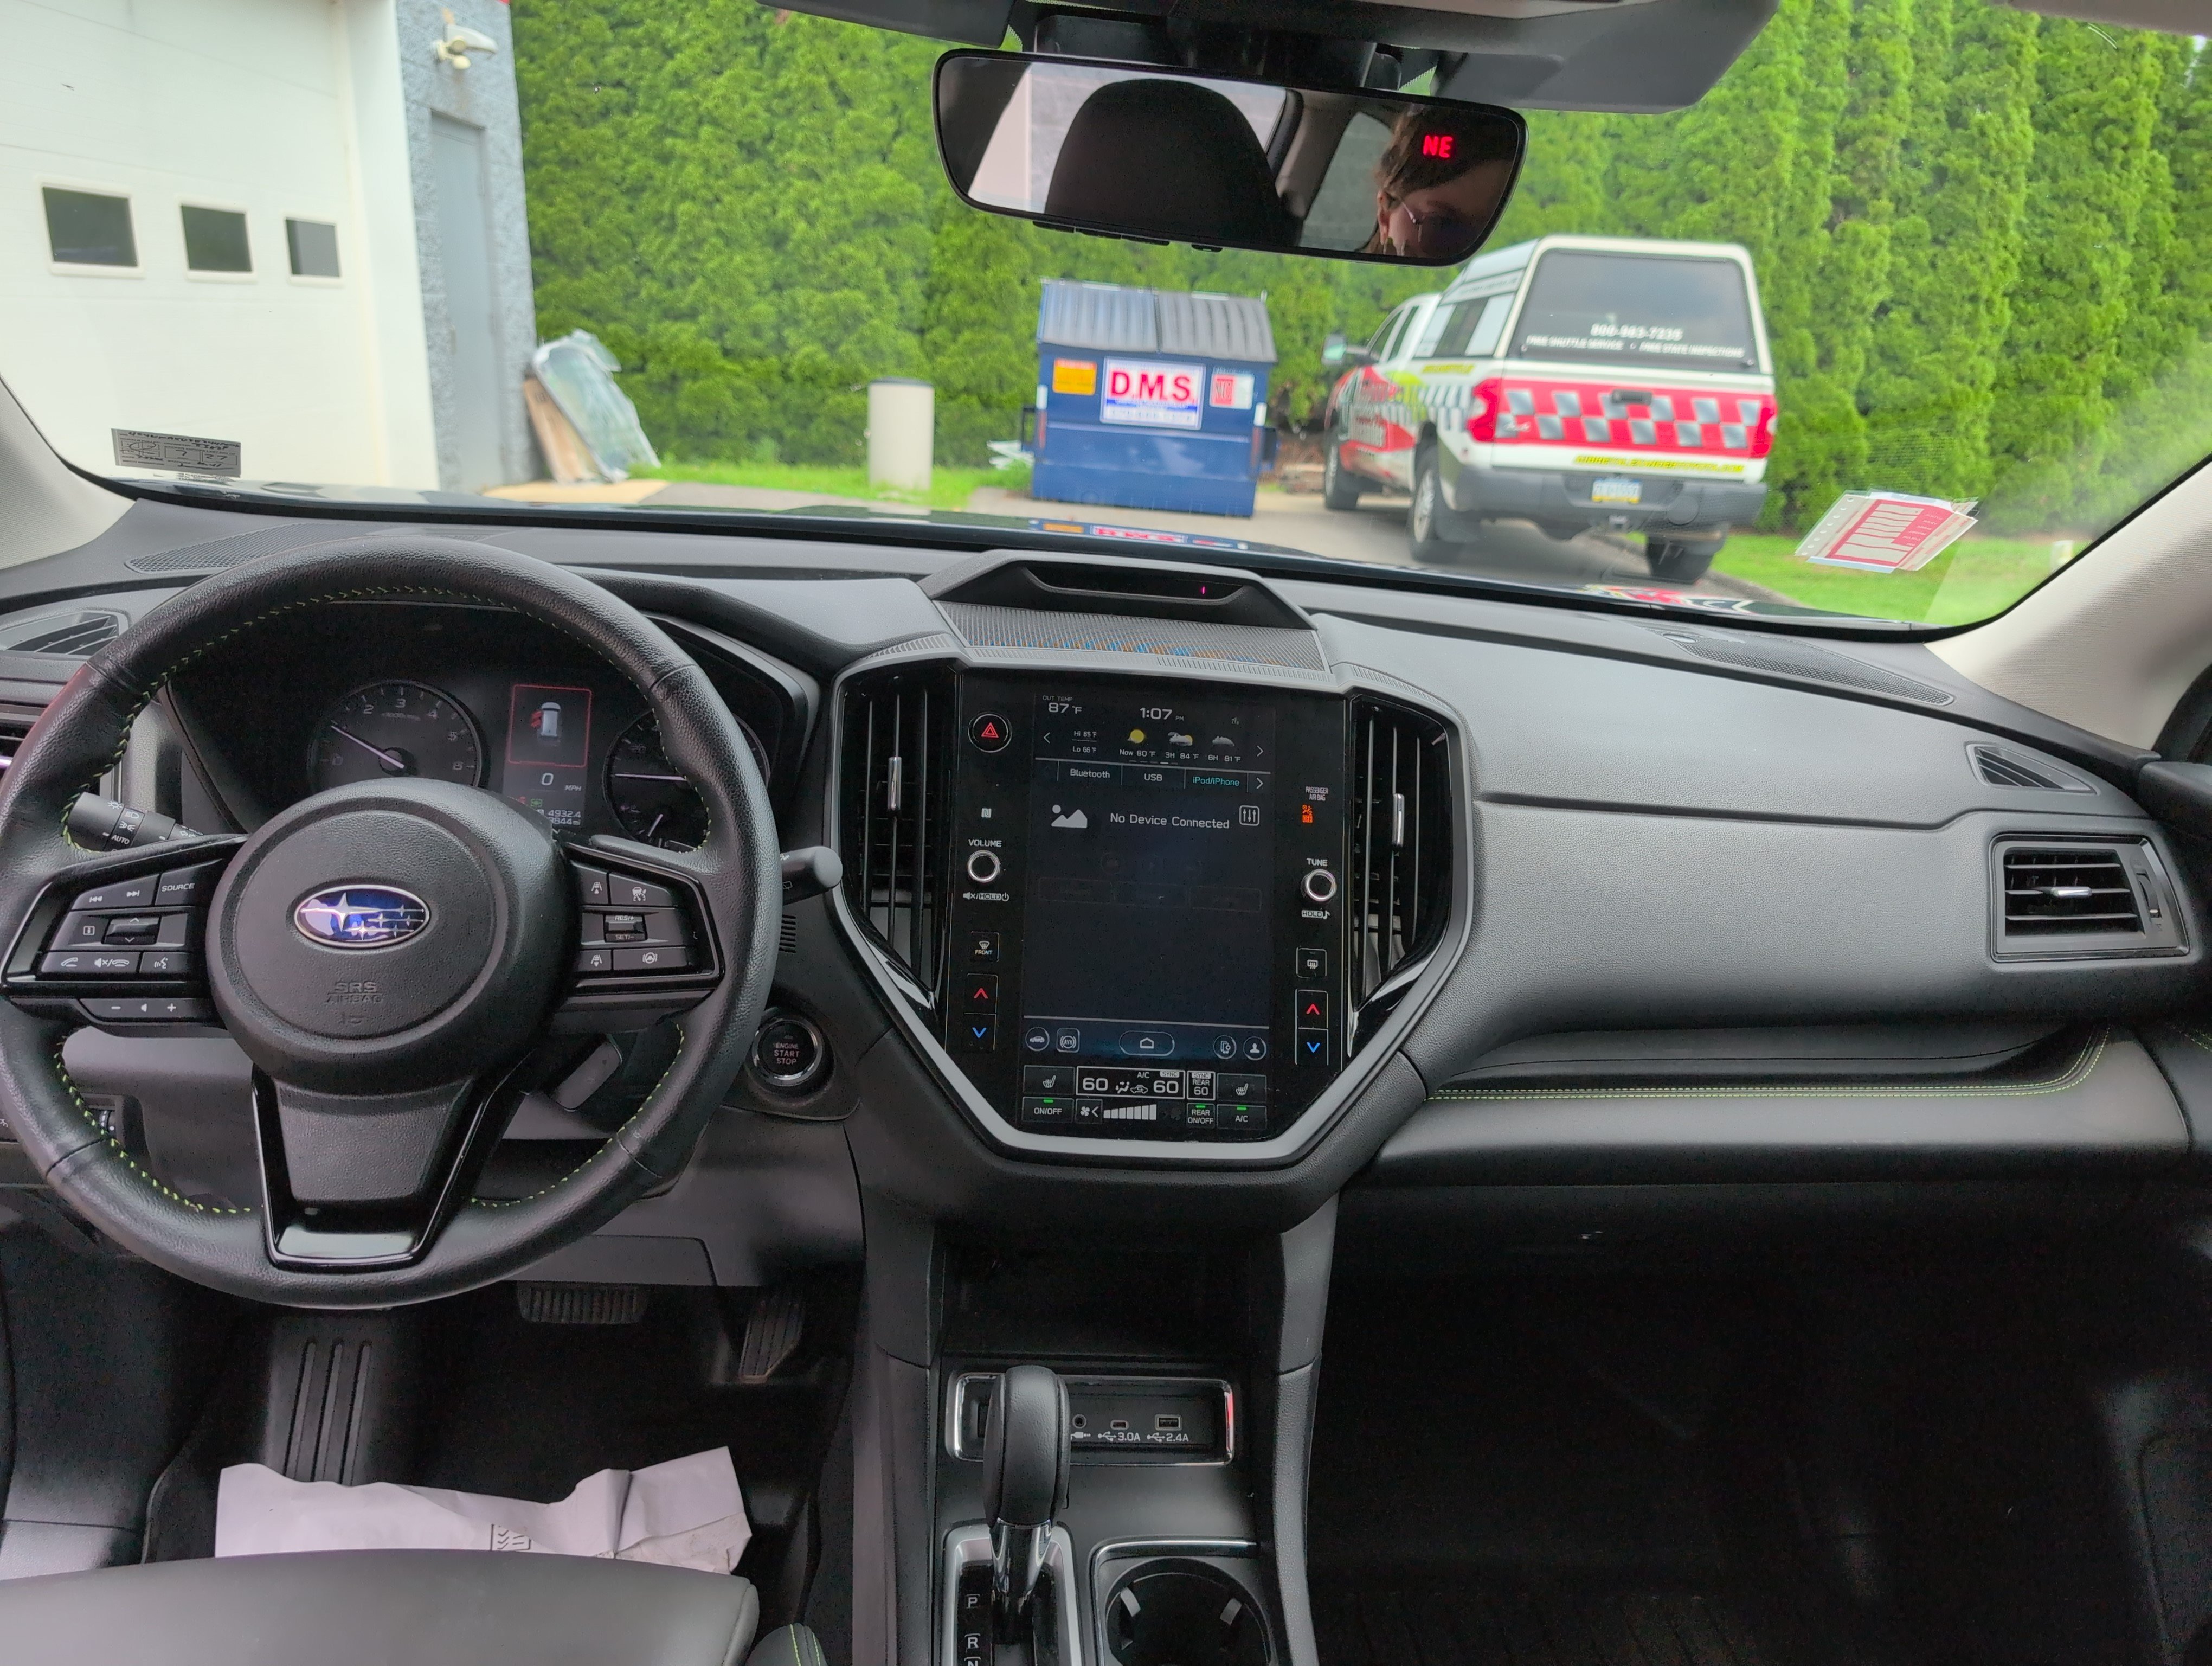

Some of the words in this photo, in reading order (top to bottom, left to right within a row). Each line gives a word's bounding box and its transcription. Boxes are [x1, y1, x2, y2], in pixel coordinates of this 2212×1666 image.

[1423, 135, 1453, 158] NE
[395, 699, 406, 708] 3
[1048, 703, 1069, 713] 87
[1140, 707, 1173, 720] 1:07
[1070, 768, 1110, 778] Bluetooth
[1144, 773, 1163, 782] USB
[541, 772, 554, 785] 0
[1192, 776, 1240, 786] iPod/iPhone
[1306, 786, 1328, 794] PASSENGER
[1110, 813, 1125, 823] No
[1130, 814, 1167, 825] Device
[1172, 816, 1230, 829] Connected
[111, 835, 130, 845] AUTO
[968, 839, 1002, 847] VOLUME
[1307, 858, 1328, 866] TUNE
[162, 883, 195, 892] SOURCE
[335, 982, 377, 993] SRS
[774, 1049, 800, 1058] START
[1082, 1078, 1108, 1091] 60
[1153, 1080, 1179, 1093] 60
[1194, 1087, 1208, 1096] 60
[1118, 1432, 1140, 1441] 3.0A
[1166, 1433, 1189, 1442] 2.4A
[968, 1597, 978, 1608] P
[968, 1637, 979, 1648] R
